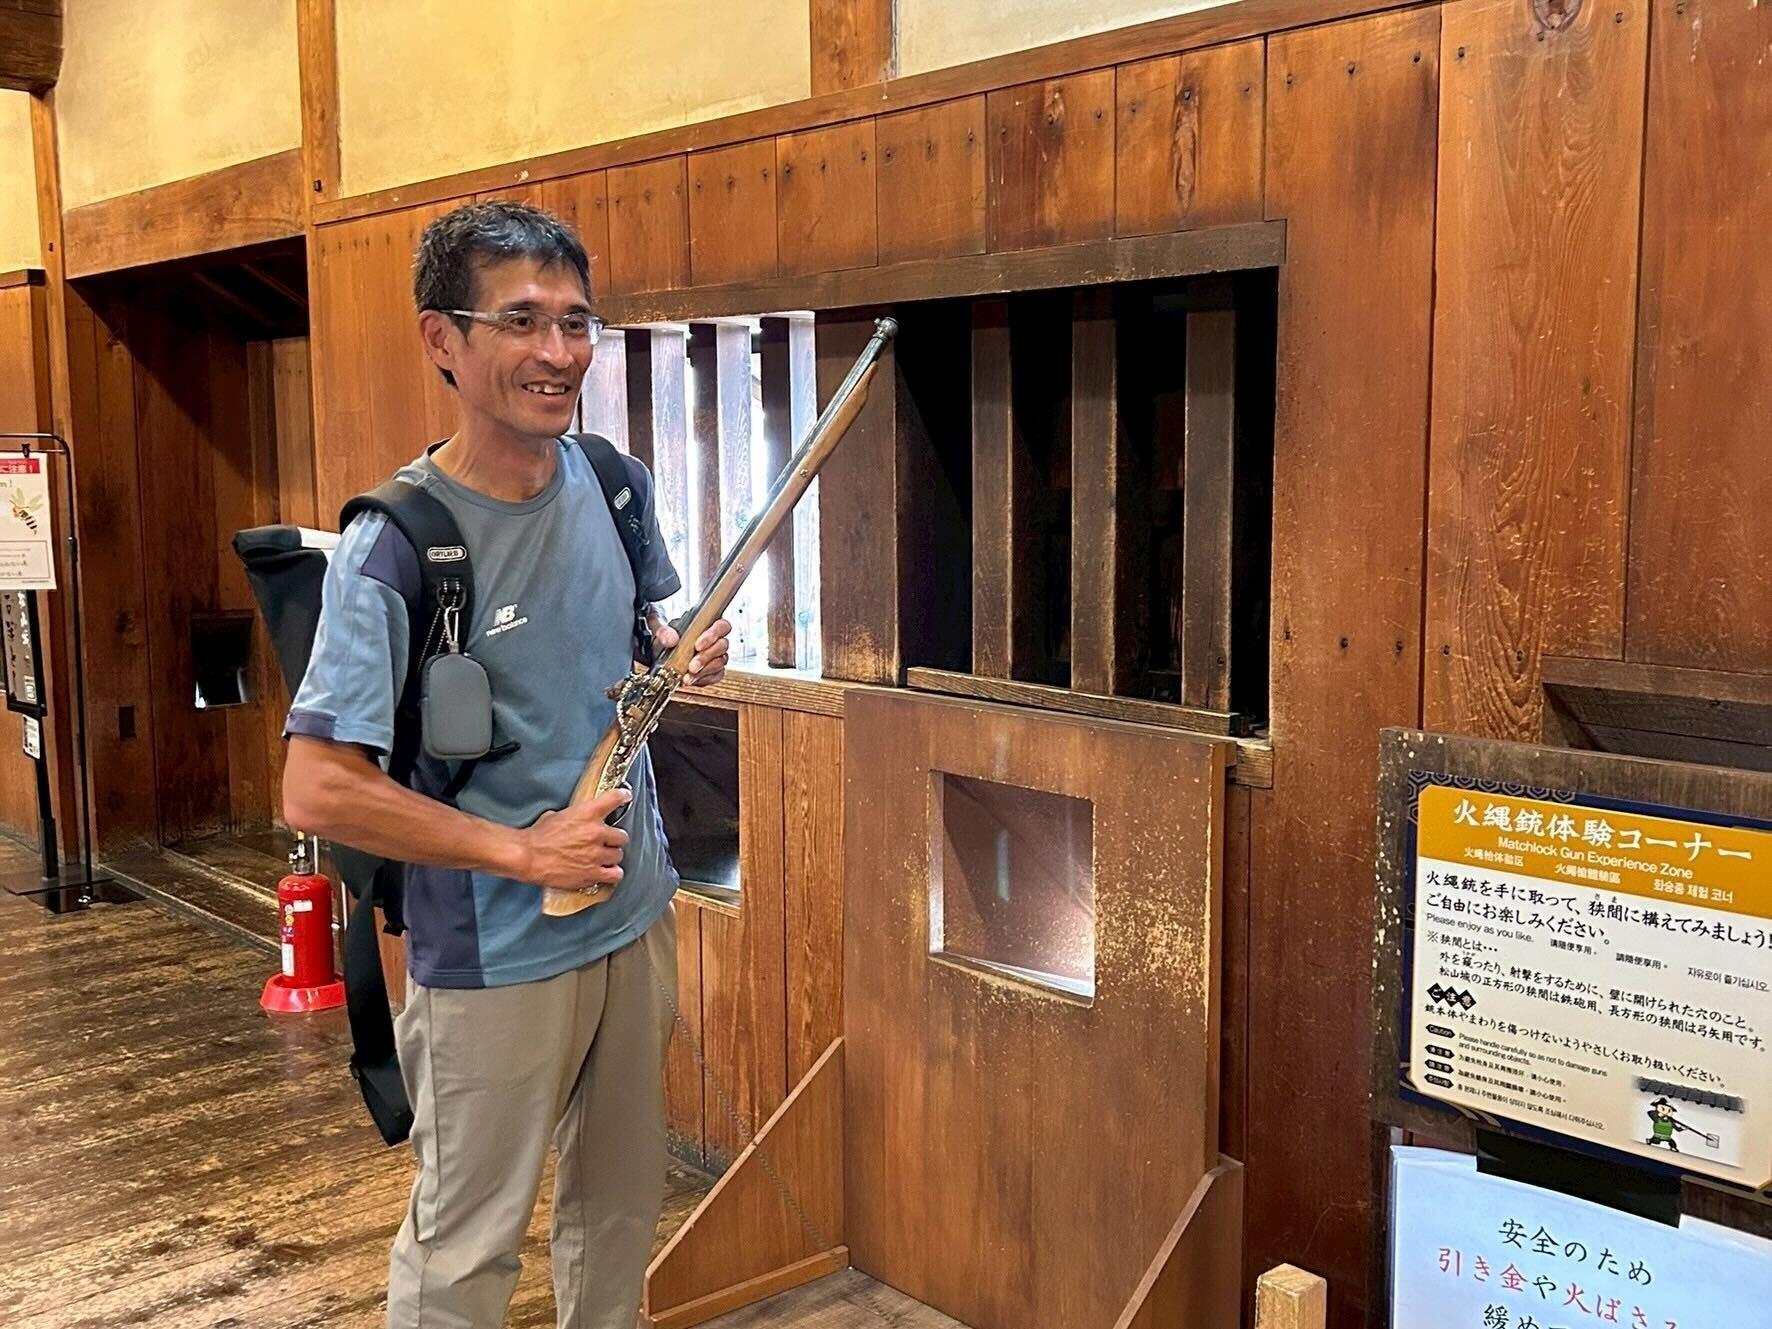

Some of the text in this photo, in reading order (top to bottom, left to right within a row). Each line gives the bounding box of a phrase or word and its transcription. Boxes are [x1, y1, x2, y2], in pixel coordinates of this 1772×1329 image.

[486, 617, 528, 637] new balance
[1454, 799, 1752, 861] 火縄銃体験コーナー
[1498, 836, 1694, 880] Matchlock Gun Experience Zone
[1711, 888, 1734, 904] 코너
[1426, 893, 1610, 945] ご自由にお楽しみください。
[1426, 912, 1535, 943] Please enjoy as you like.
[1498, 1218, 1652, 1286] 安全のため
